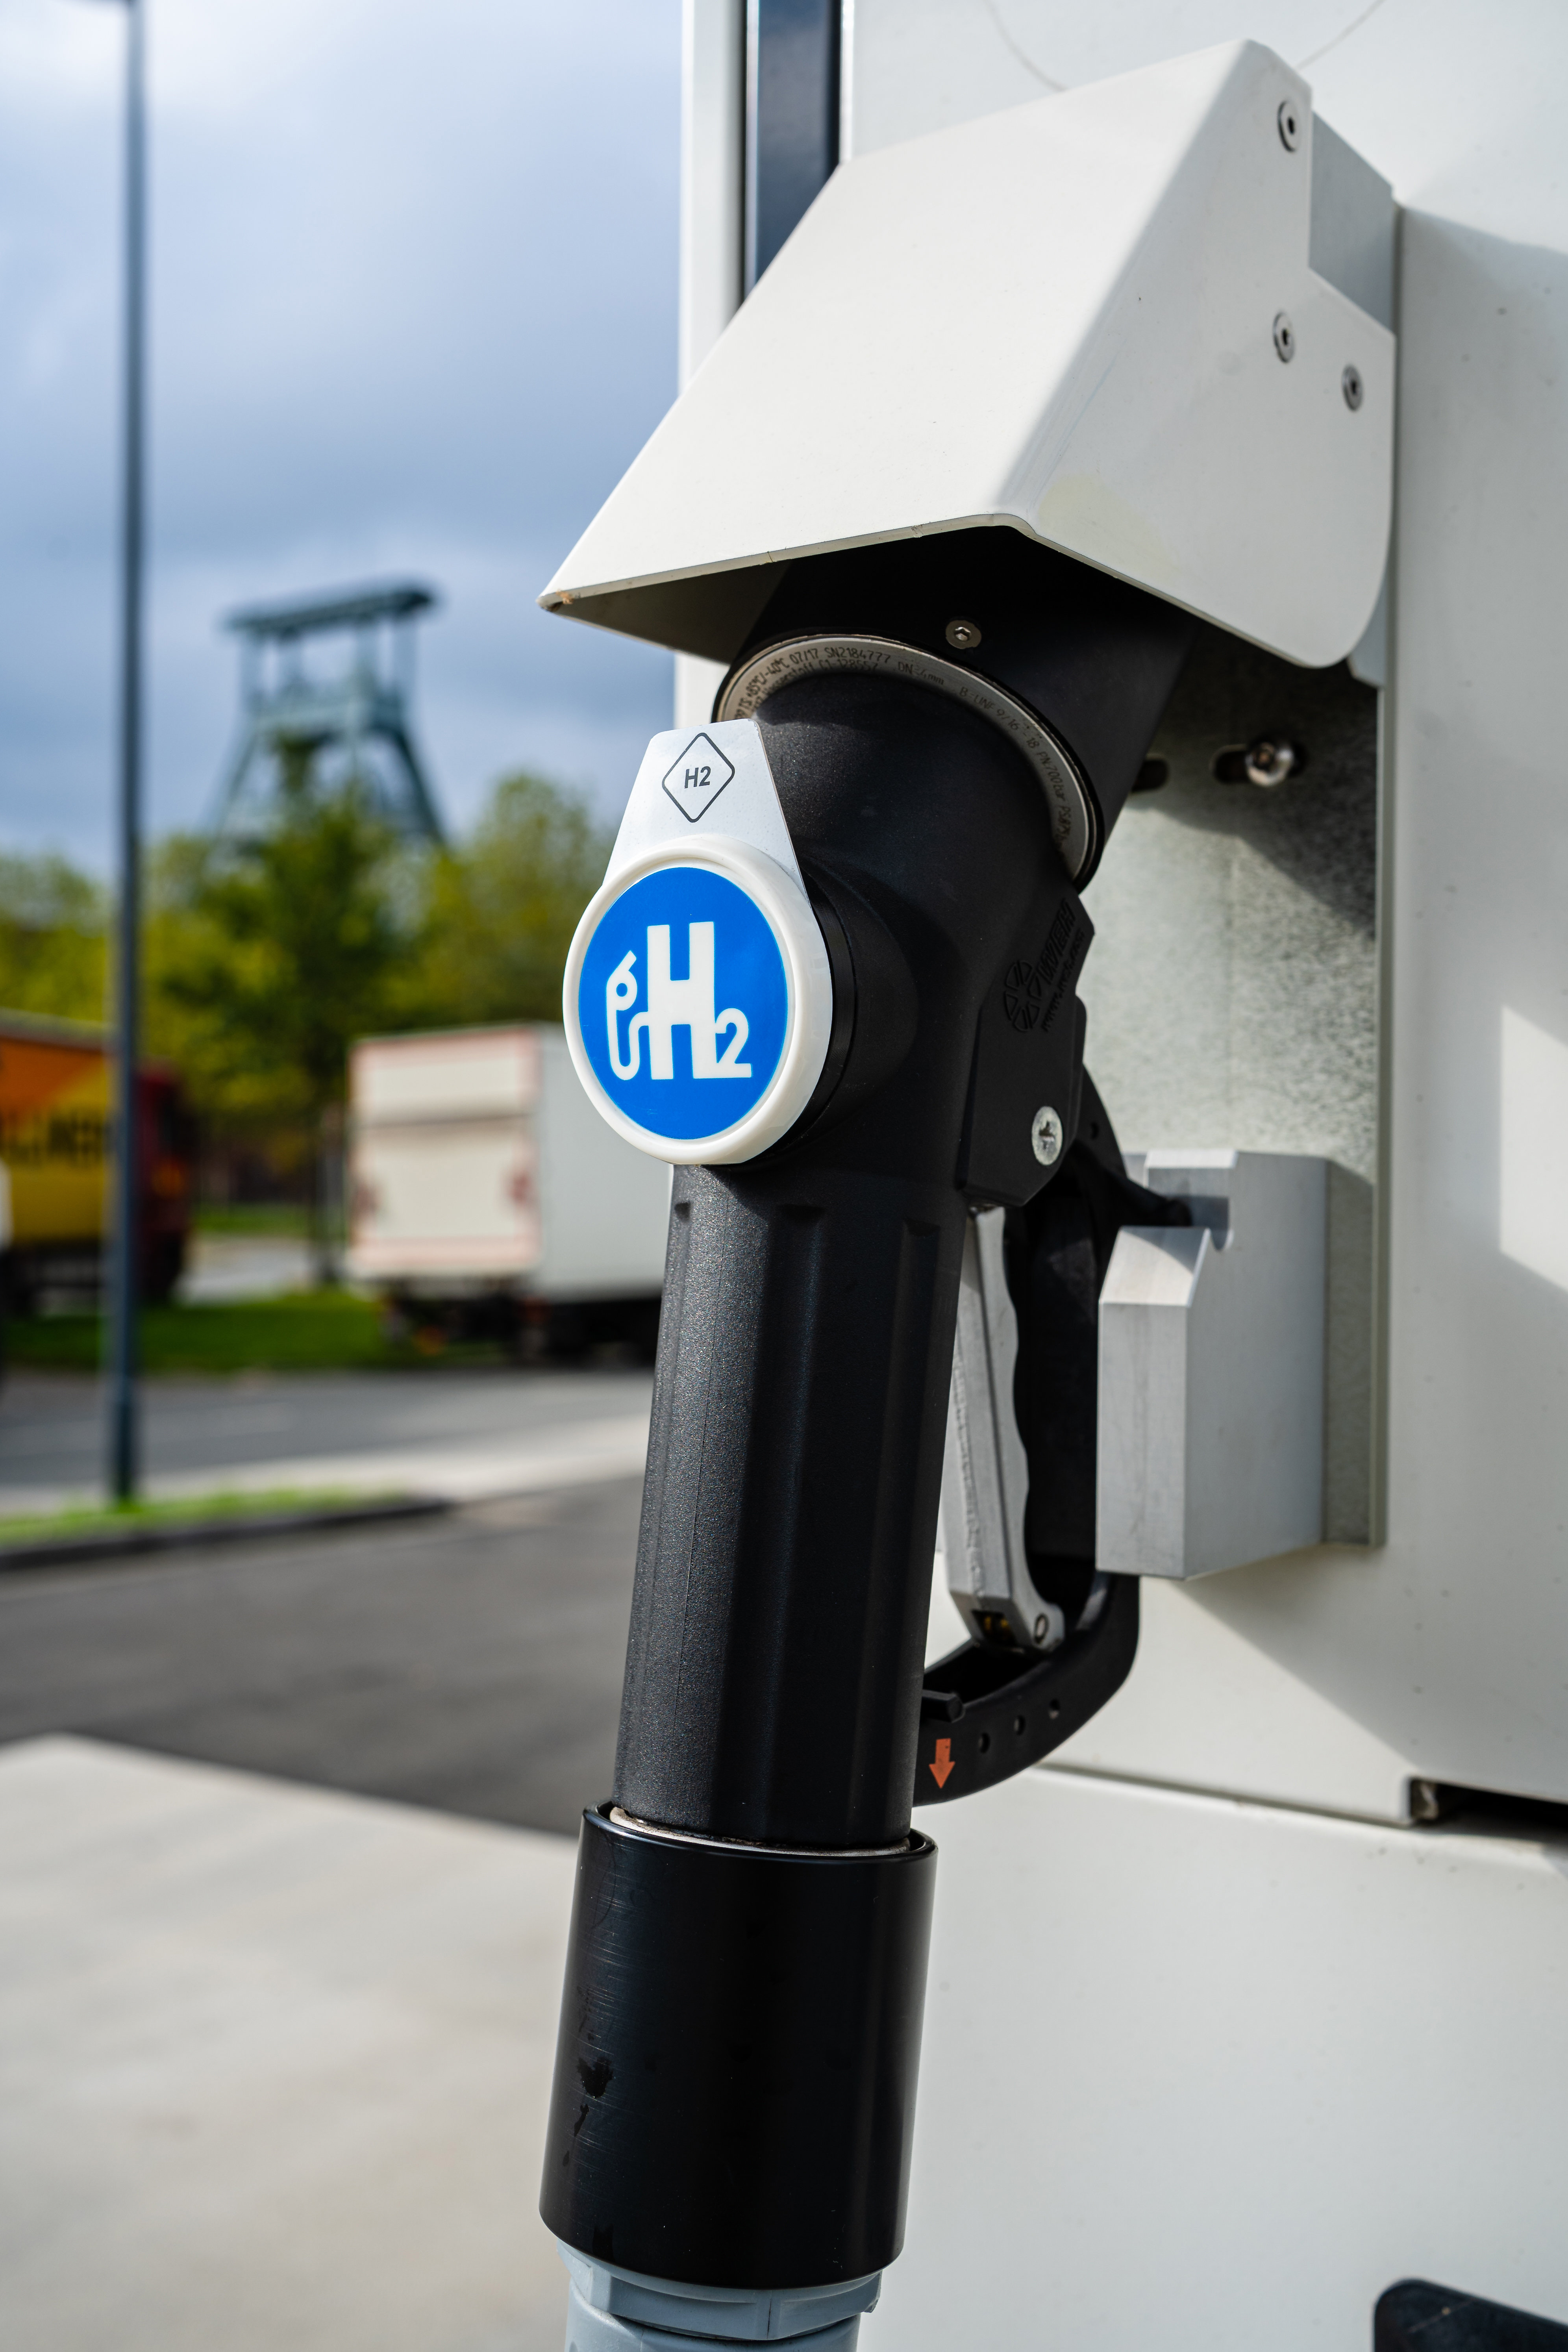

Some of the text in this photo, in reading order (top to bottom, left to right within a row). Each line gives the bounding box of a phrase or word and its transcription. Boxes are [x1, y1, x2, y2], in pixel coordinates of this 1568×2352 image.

[789, 648, 818, 664] 07/17
[824, 647, 891, 663] SN2184777
[684, 766, 711, 789] H2
[1036, 897, 1076, 984] WEH
[647, 921, 752, 1080] H2
